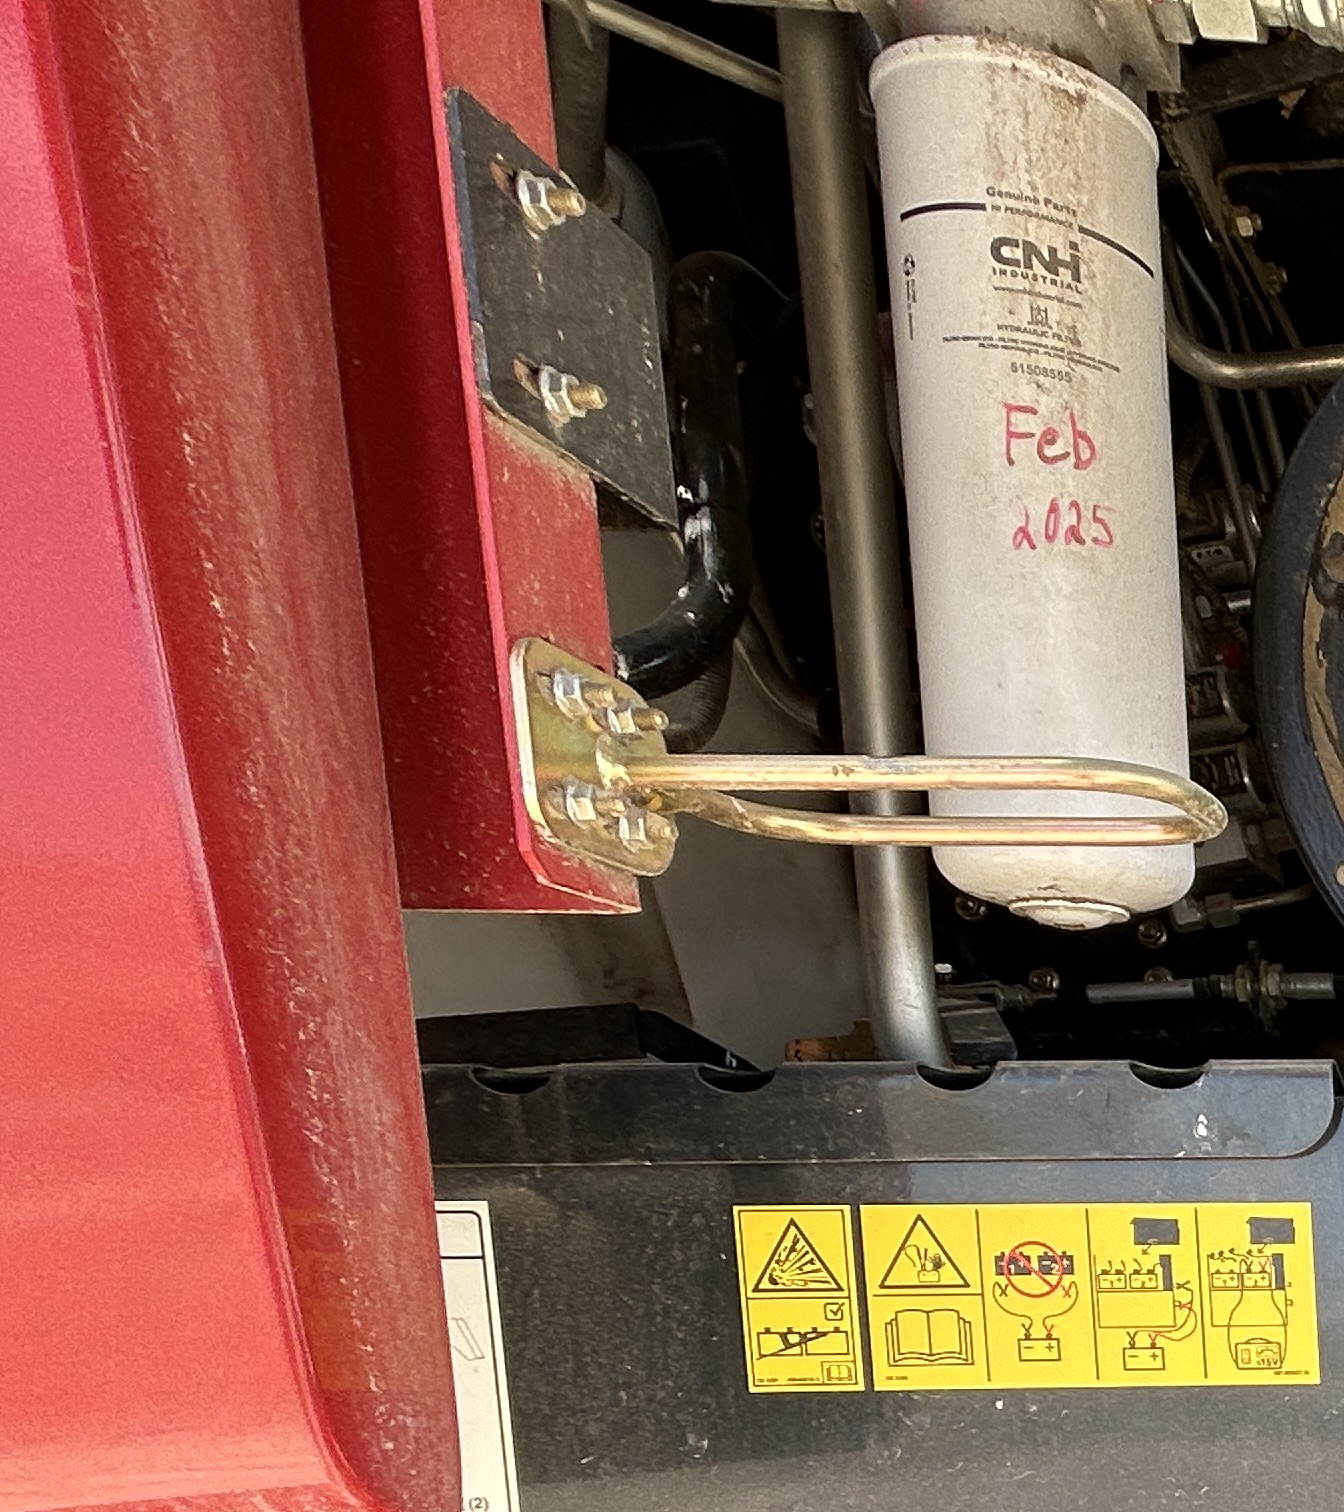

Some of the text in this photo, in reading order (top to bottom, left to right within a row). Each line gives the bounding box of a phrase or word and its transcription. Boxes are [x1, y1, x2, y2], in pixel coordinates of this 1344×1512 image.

[991, 265, 1083, 295] INDUSTRIAL
[996, 323, 1050, 339] HYDRAULIC
[1002, 401, 1098, 471] Feb
[1012, 496, 1118, 551] 2025
[468, 1496, 490, 1512] (2)
